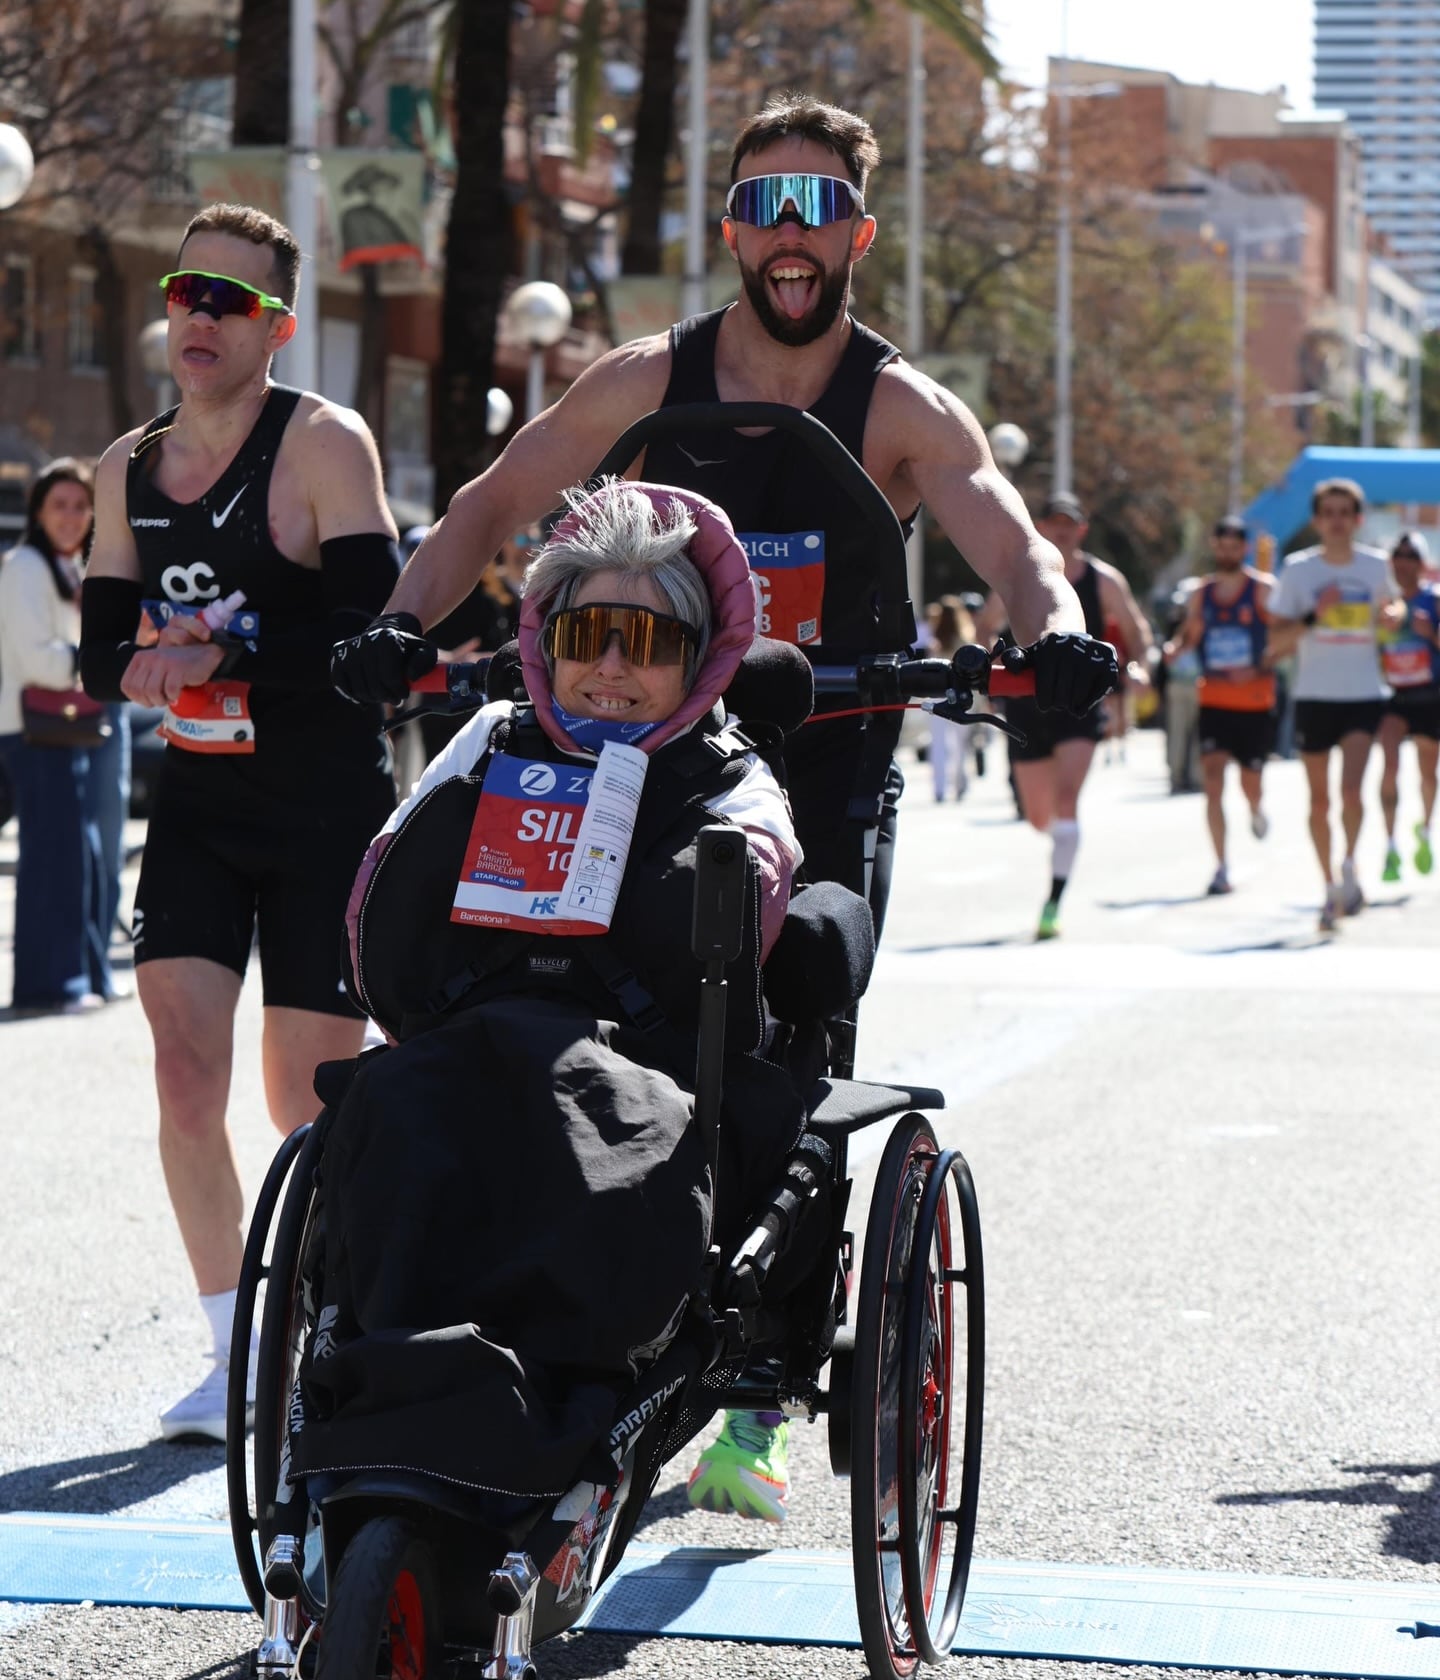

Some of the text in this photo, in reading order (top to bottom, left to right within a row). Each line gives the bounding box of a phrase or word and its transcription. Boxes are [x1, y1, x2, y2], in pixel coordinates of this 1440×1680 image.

[517, 809, 578, 845] SIL
[474, 872, 497, 881] START
[460, 911, 503, 924] Barcelona
